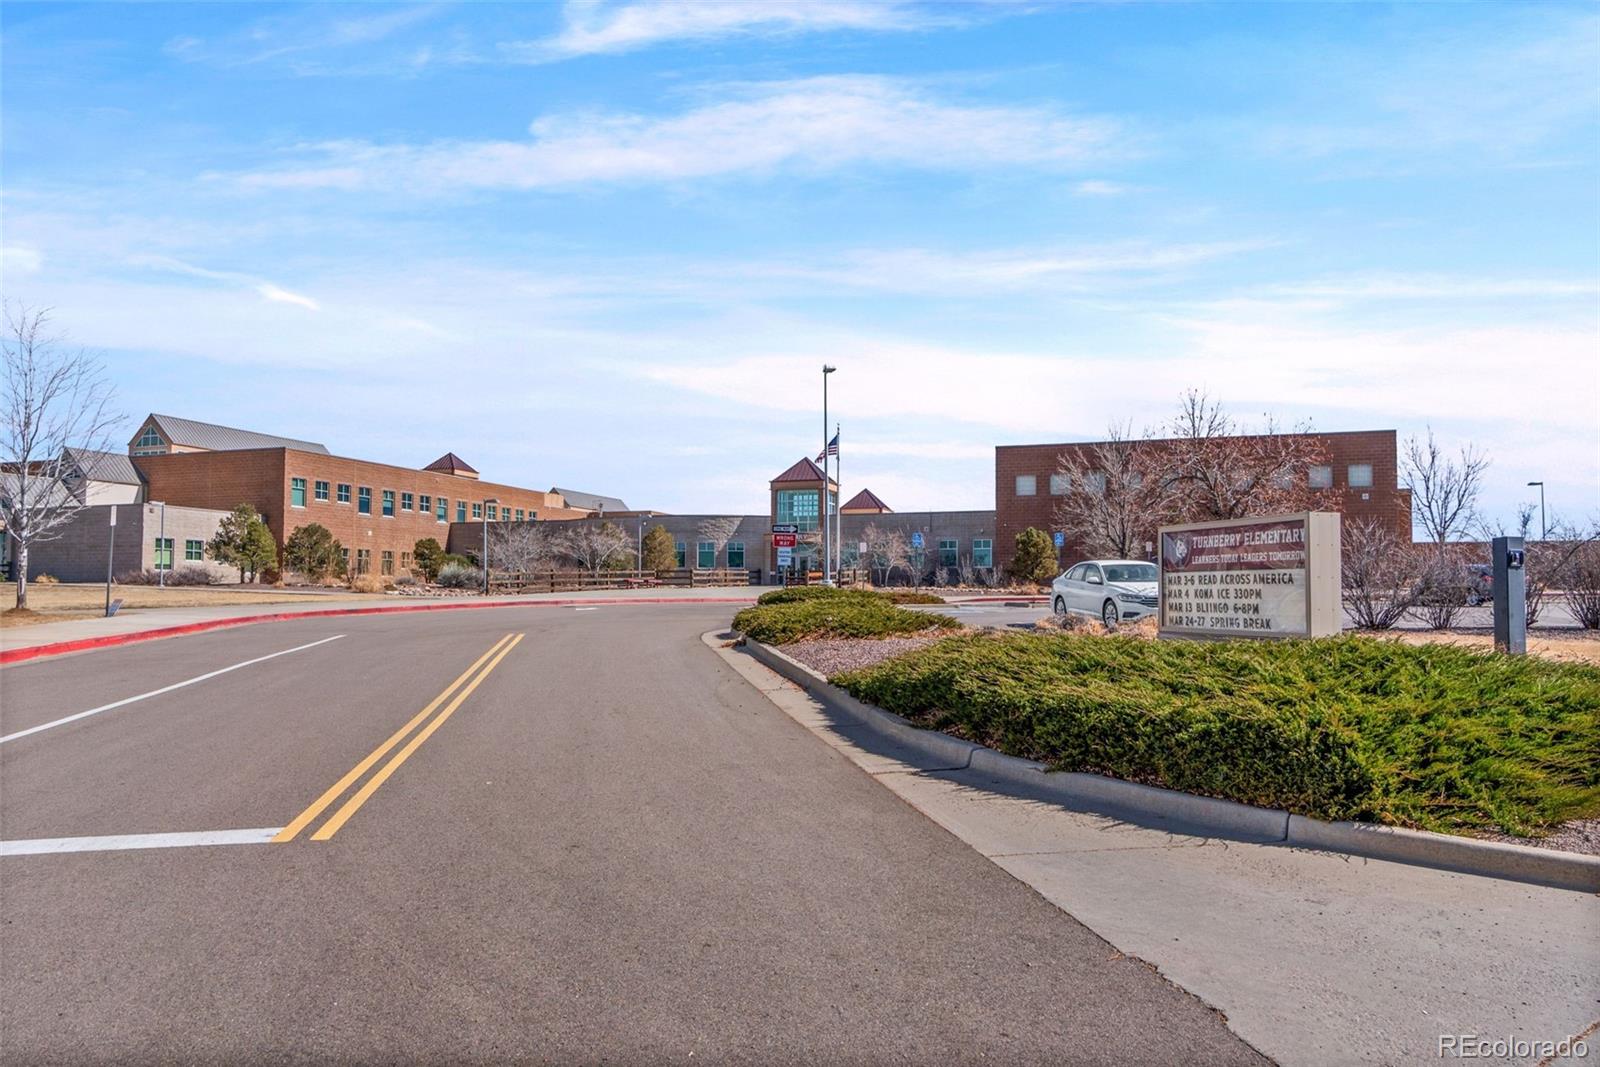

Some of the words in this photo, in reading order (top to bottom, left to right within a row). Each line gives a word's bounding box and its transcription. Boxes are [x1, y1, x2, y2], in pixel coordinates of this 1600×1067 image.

[1193, 533, 1241, 548] TURNBERRY
[1244, 529, 1305, 545] ELEMENTARY
[1192, 555, 1219, 564] LEARNERS
[1240, 552, 1267, 562] LEADERS
[1168, 576, 1181, 586] MAR
[1184, 575, 1195, 586] 3-6
[1199, 575, 1217, 585] READ
[1220, 574, 1250, 585] ACROSS
[1253, 573, 1294, 584] AMERICA
[1168, 589, 1182, 599] MAR
[1185, 589, 1189, 599] 4
[1217, 589, 1230, 599] ICE
[1234, 589, 1262, 599] 330PM
[1168, 603, 1182, 613] MAR
[1185, 602, 1192, 612] 13
[1233, 603, 1259, 614] 6-8PM
[1169, 616, 1183, 626] MAR
[1185, 616, 1205, 626] 24-27
[1210, 617, 1240, 628] SPRING
[1244, 618, 1271, 629] BREAK
